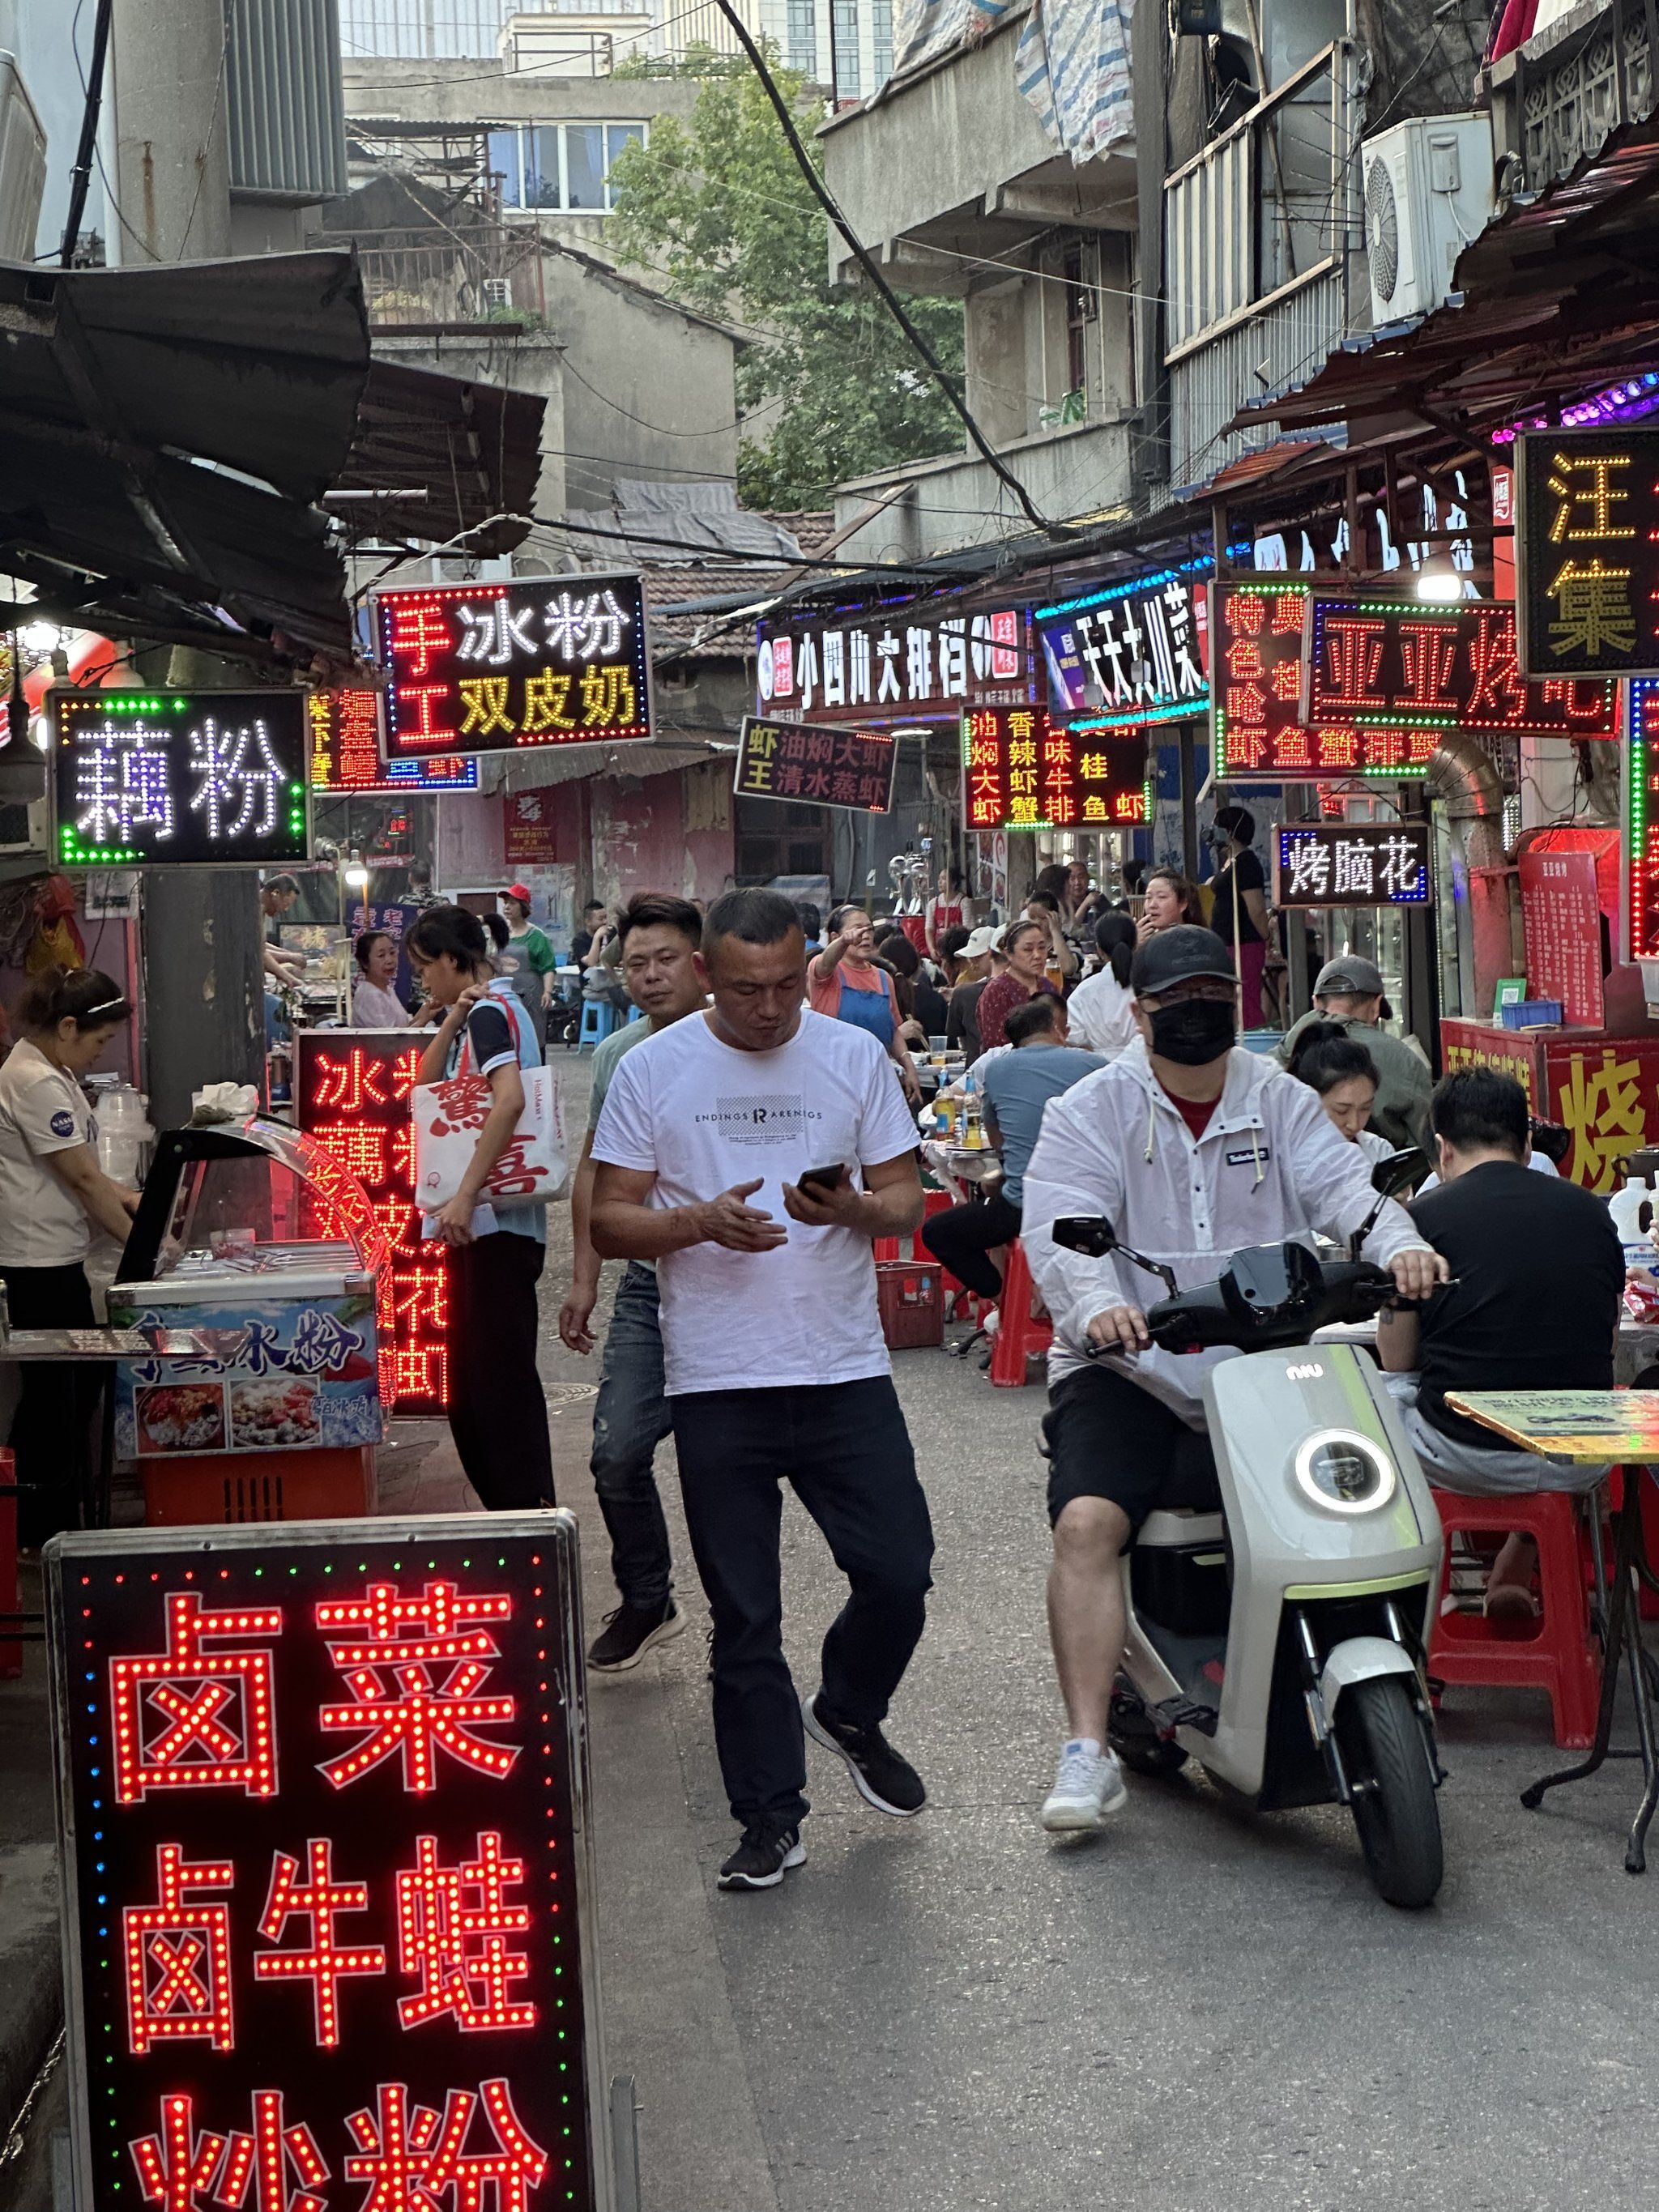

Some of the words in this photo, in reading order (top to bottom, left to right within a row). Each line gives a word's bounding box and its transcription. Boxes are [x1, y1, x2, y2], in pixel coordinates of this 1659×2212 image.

[1546, 450, 1637, 656] 汪集
[391, 605, 456, 747] 手工
[456, 589, 630, 664] 冰粉
[796, 616, 968, 710] 小四川大排档
[1225, 593, 1268, 769] 特色呛虾
[458, 664, 636, 735] 双皮奶
[778, 730, 892, 772] 油焖大虾
[75, 718, 287, 844] 藕粉
[744, 723, 780, 791] 虾王
[776, 763, 888, 805] 清水蒸虾
[971, 710, 1003, 824] 油焖大虾
[1007, 710, 1038, 823] 香辣虾蟹
[1079, 728, 1111, 821] 桂鱼
[1288, 835, 1419, 896] 烤脑花
[695, 1112, 748, 1123] ENDINGS
[1559, 1049, 1649, 1194] 烧
[108, 1580, 522, 1804] 卤菜
[122, 1831, 535, 2055] 卤牛蛙
[129, 2076, 548, 2212] 炒粉
